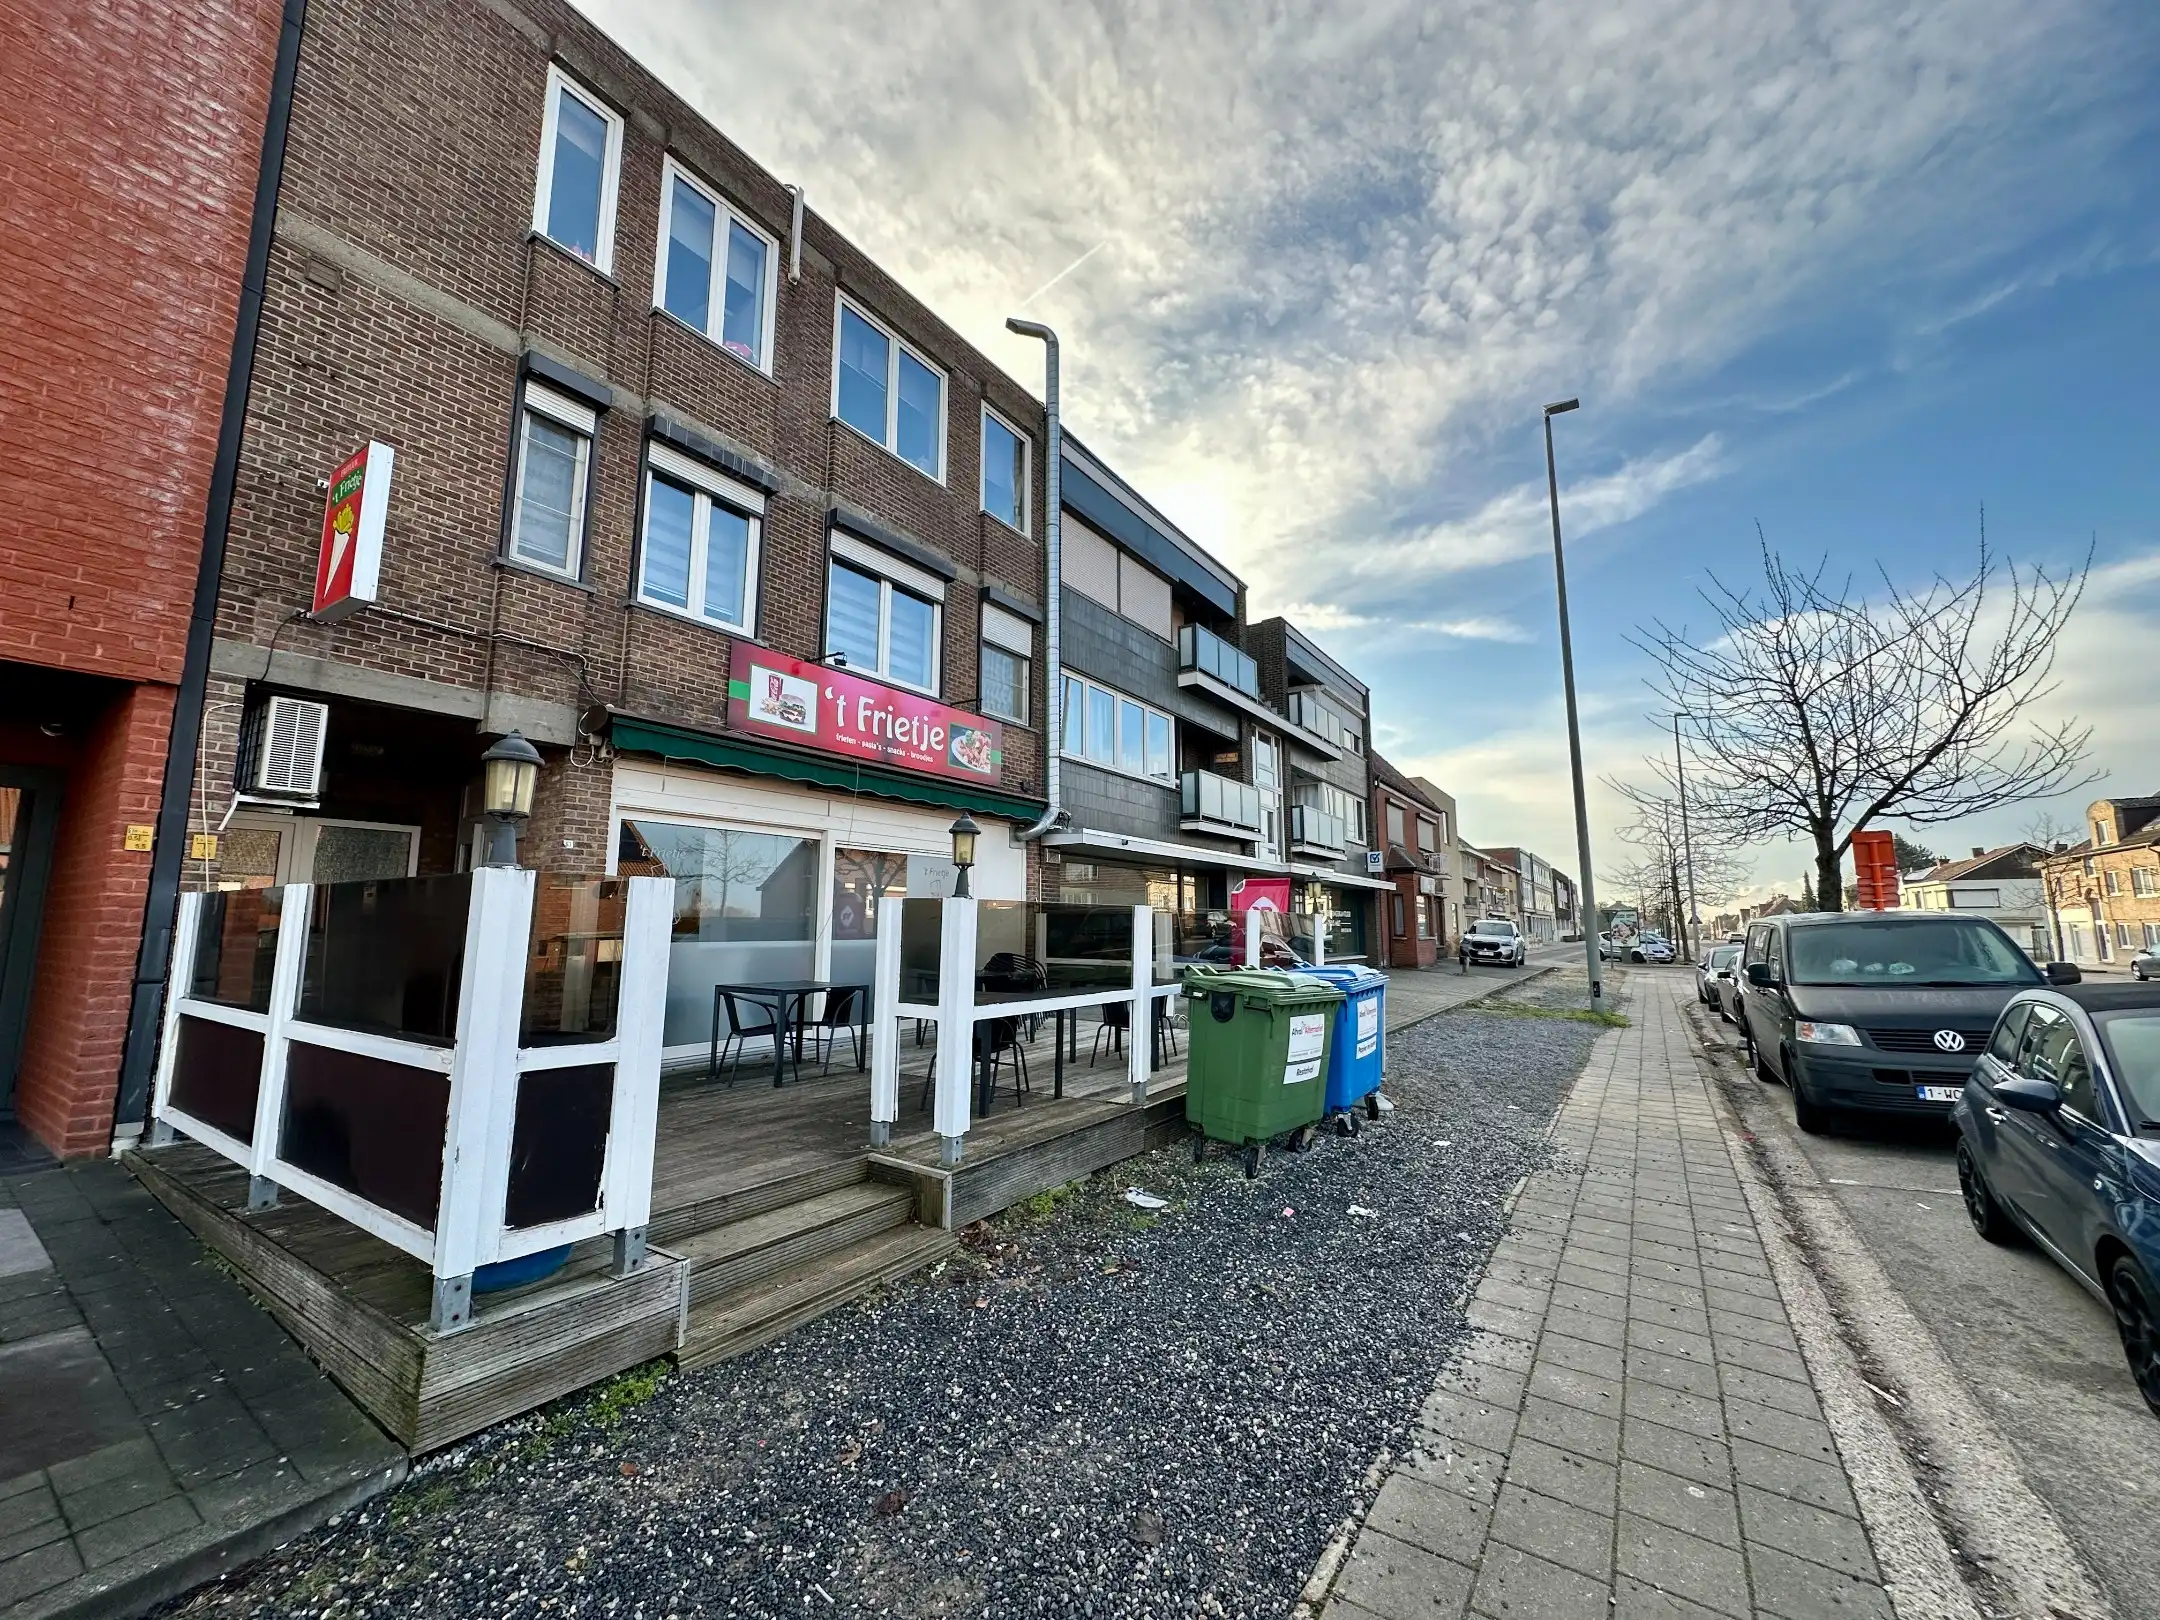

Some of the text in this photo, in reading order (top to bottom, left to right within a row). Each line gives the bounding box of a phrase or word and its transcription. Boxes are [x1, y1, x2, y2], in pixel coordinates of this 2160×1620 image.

[857, 695, 945, 752] Frietje
[835, 732, 934, 763] frieten pasta's snacks broodjes
[1927, 1088, 1962, 1100] 1-WC
